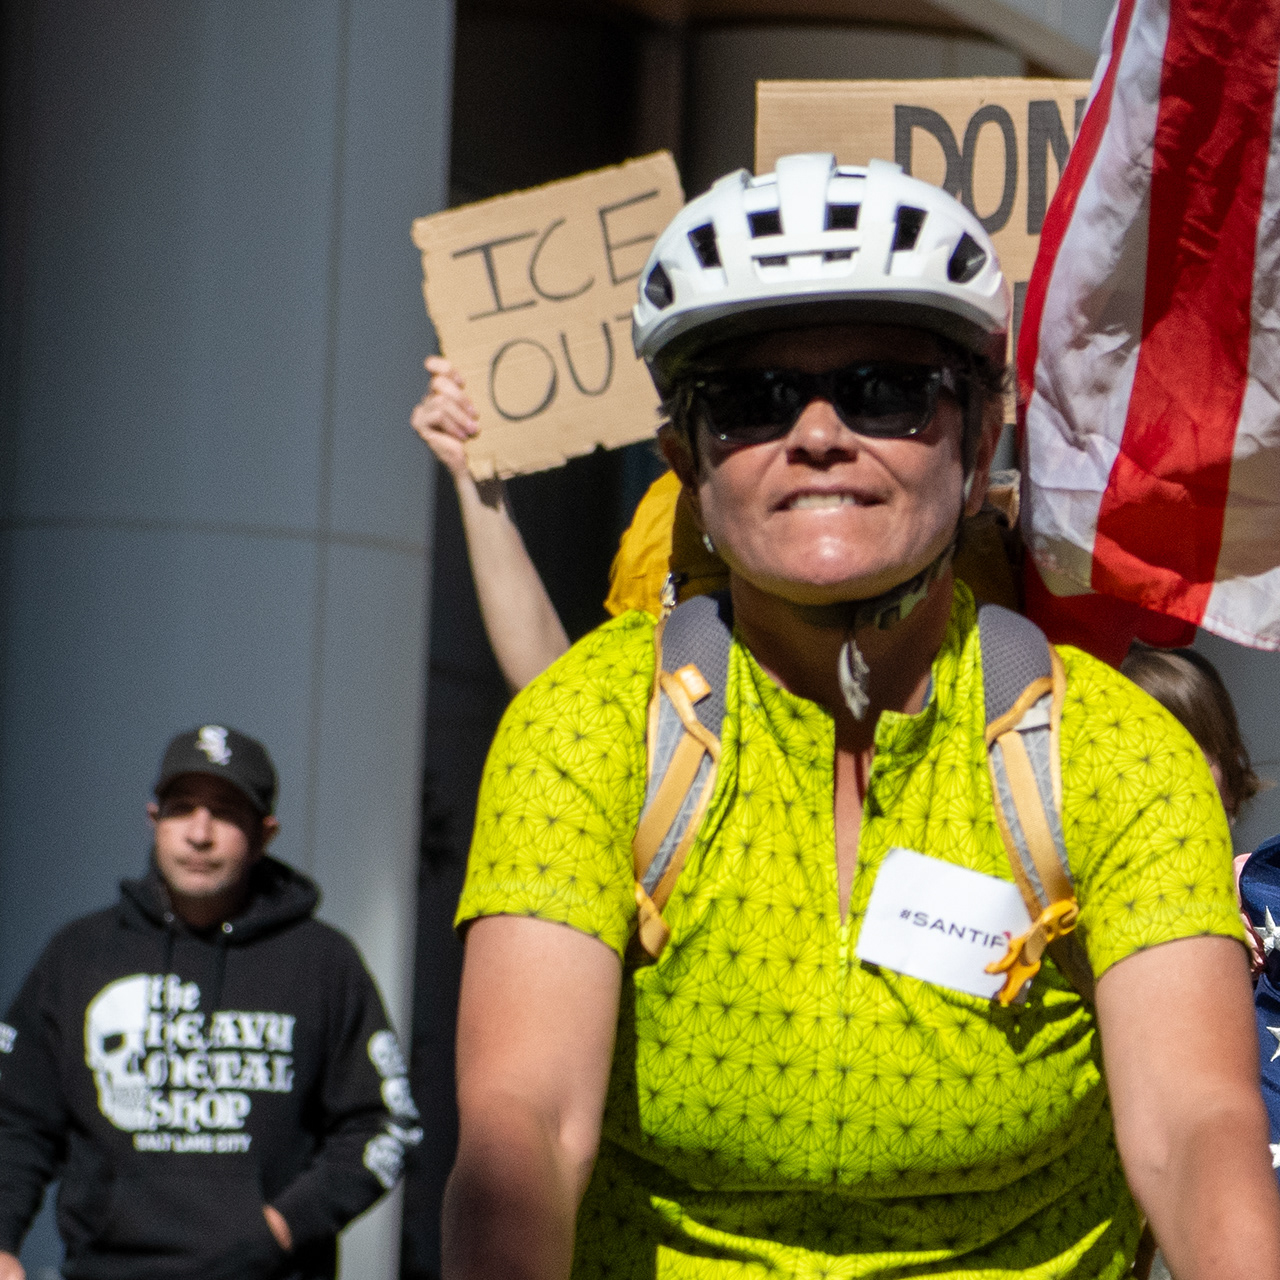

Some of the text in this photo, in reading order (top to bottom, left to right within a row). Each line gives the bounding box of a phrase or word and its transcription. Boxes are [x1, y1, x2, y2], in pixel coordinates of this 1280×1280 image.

[893, 99, 1083, 236] DON
[452, 189, 660, 322] ICE
[489, 311, 632, 422] OU
[899, 907, 1007, 949] #SANTIF
